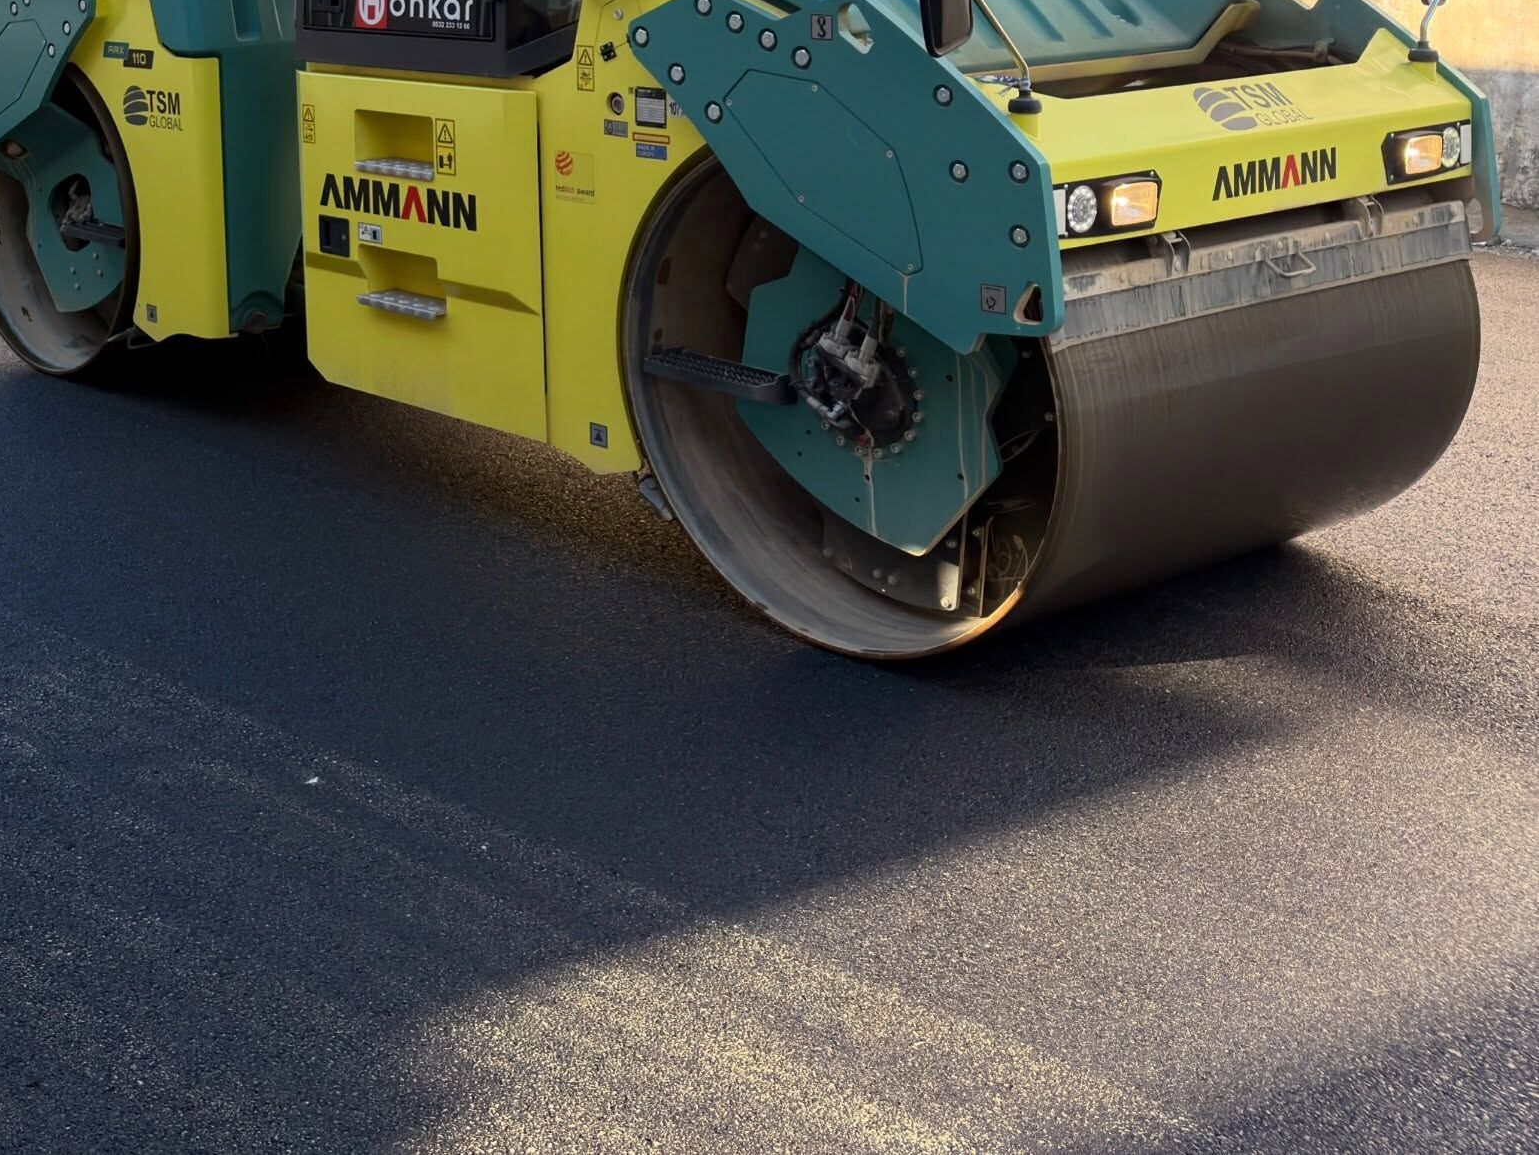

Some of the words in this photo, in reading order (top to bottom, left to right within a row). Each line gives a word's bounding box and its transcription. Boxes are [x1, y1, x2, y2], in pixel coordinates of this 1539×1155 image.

[107, 45, 125, 55] ARX
[132, 52, 147, 65] 110
[146, 90, 180, 115] TSM
[1223, 82, 1294, 110] TSM
[149, 114, 184, 131] GLOBAL
[1255, 107, 1315, 127] GLOBAL
[1212, 147, 1337, 202] AMMANN
[319, 173, 477, 232] AMMANN
